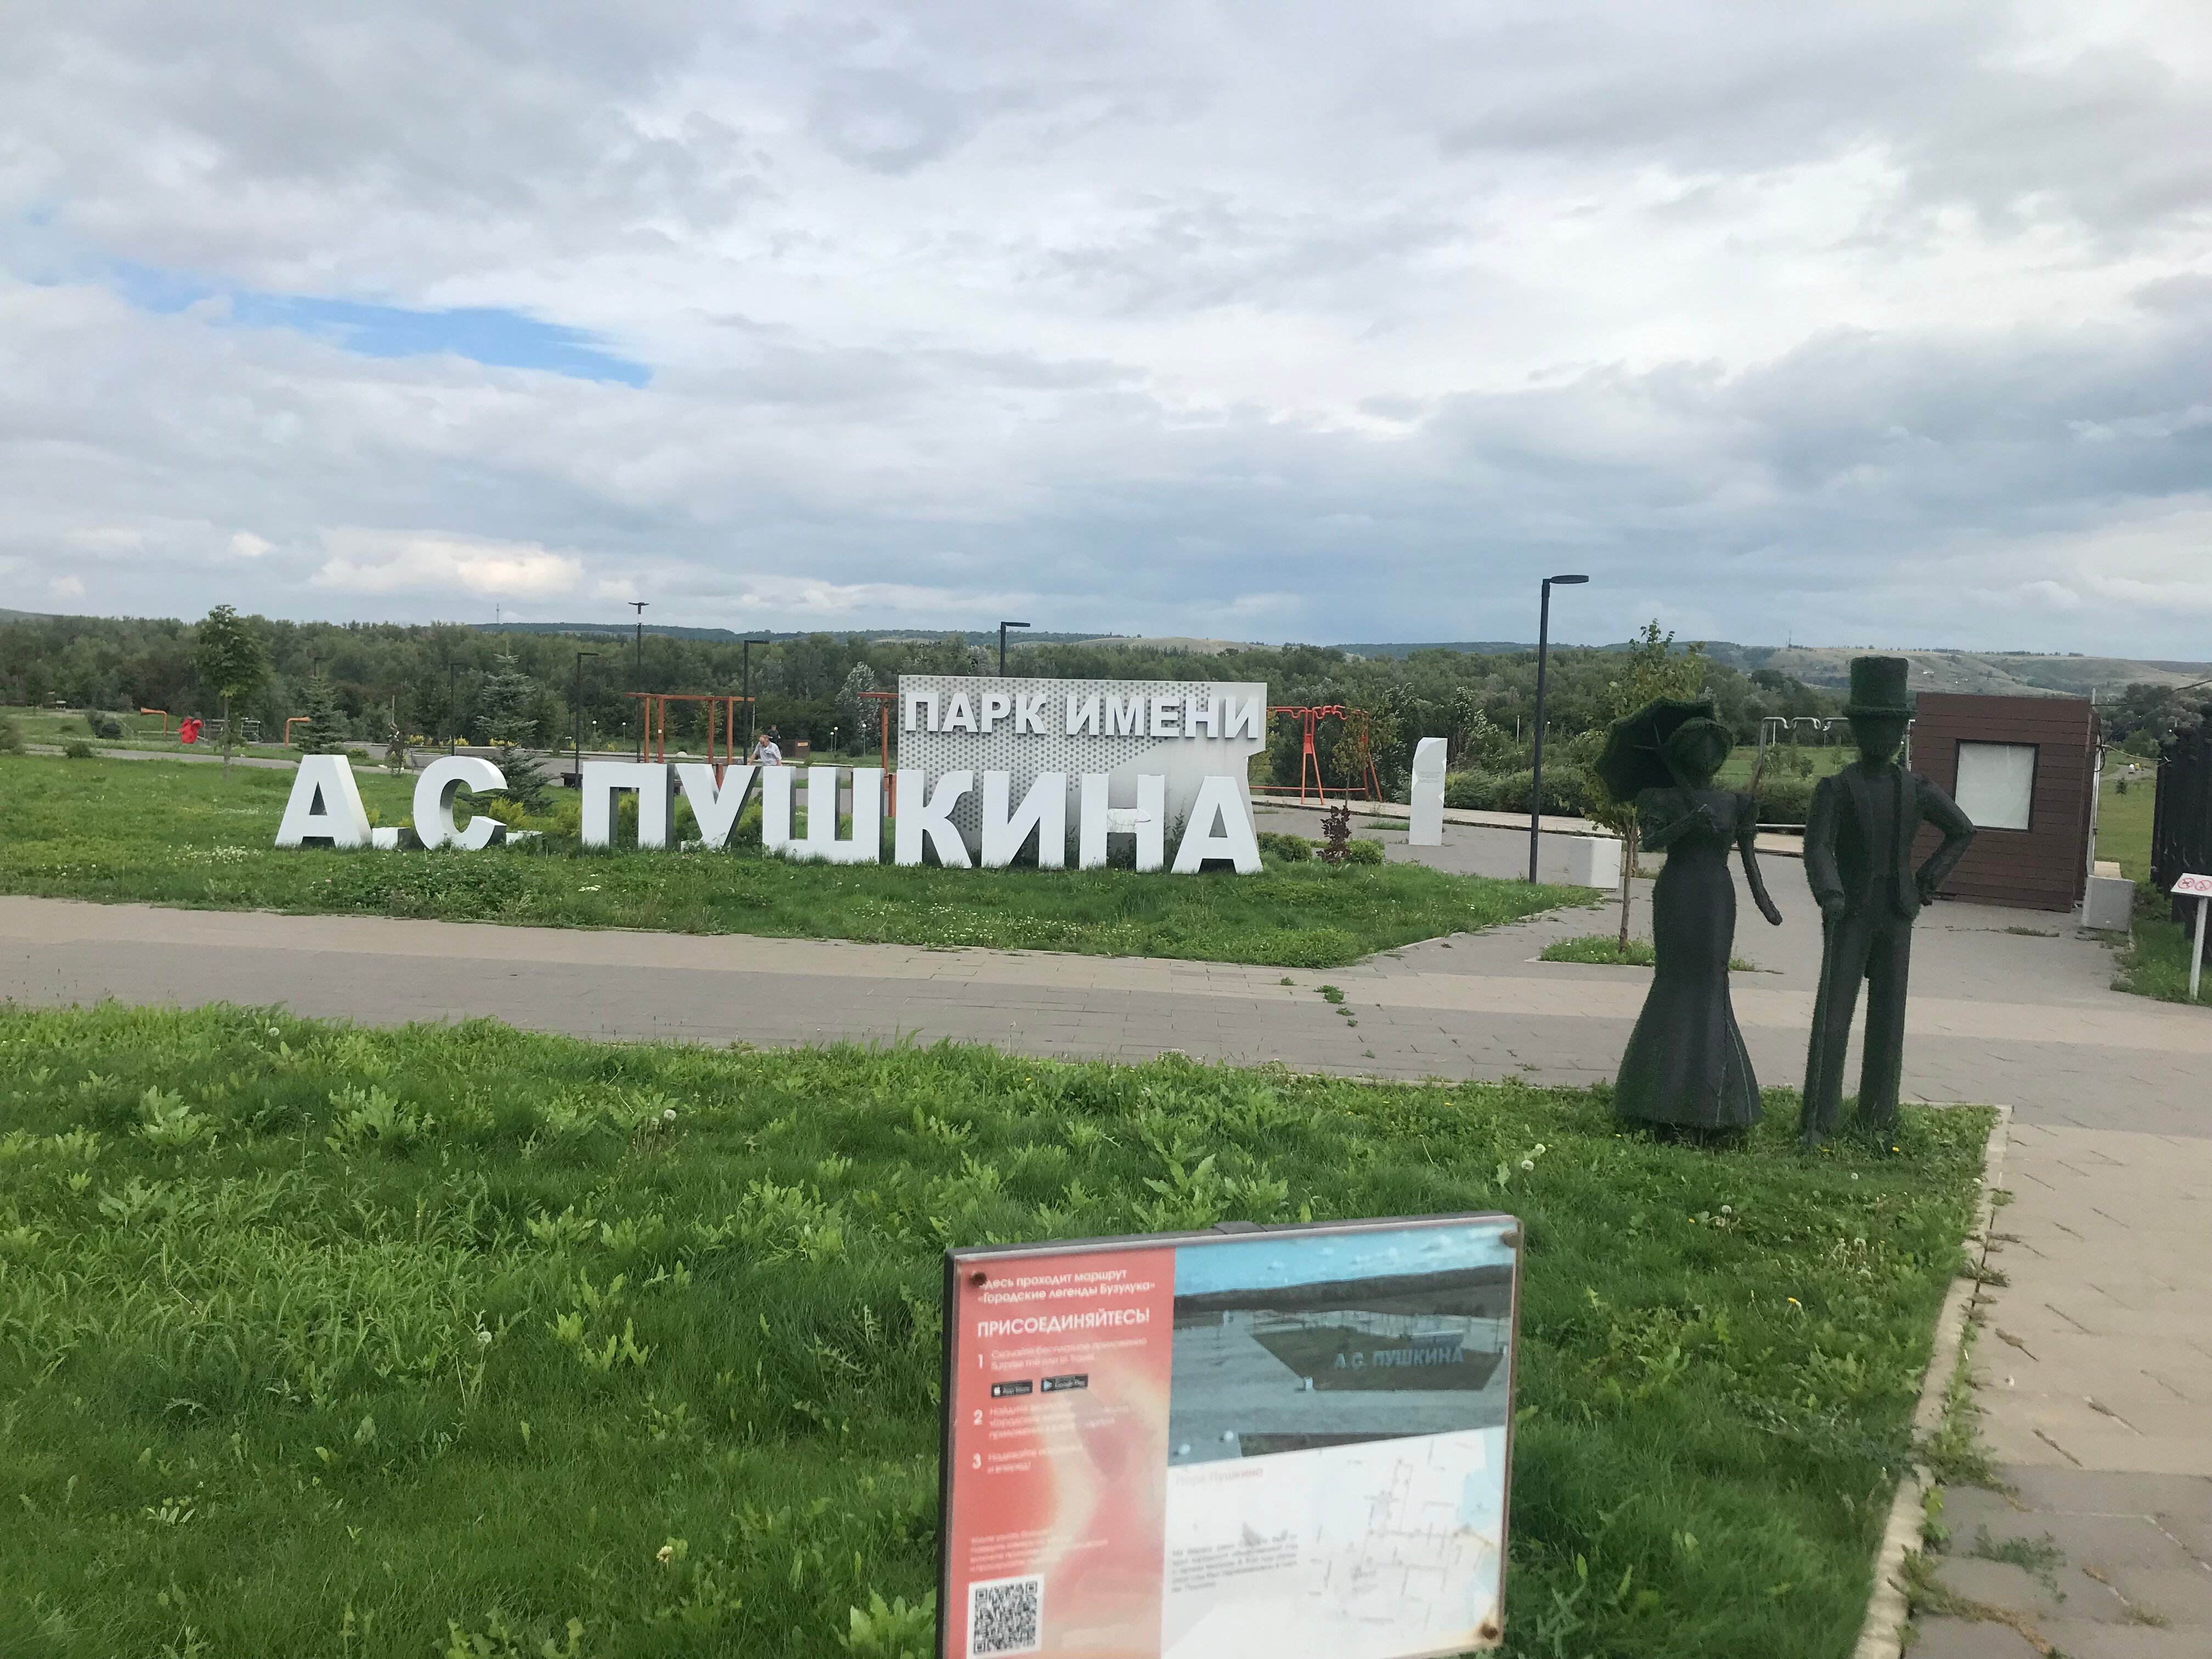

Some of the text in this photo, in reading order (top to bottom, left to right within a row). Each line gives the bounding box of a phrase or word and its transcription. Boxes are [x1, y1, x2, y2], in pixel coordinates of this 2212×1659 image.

[905, 691, 1260, 738] ПАРК ИМЕНИ
[582, 761, 1263, 874] ПУШКИНА
[979, 1269, 1127, 1290] десь проходит маршрут
[978, 1282, 1156, 1305] «Городские легенды Бузулука»
[978, 1307, 1150, 1338] ПРИСОЕДИНЯЙТЕСЬ!
[978, 1354, 983, 1369] 1
[974, 1409, 983, 1426] 2
[973, 1453, 981, 1470] 3
